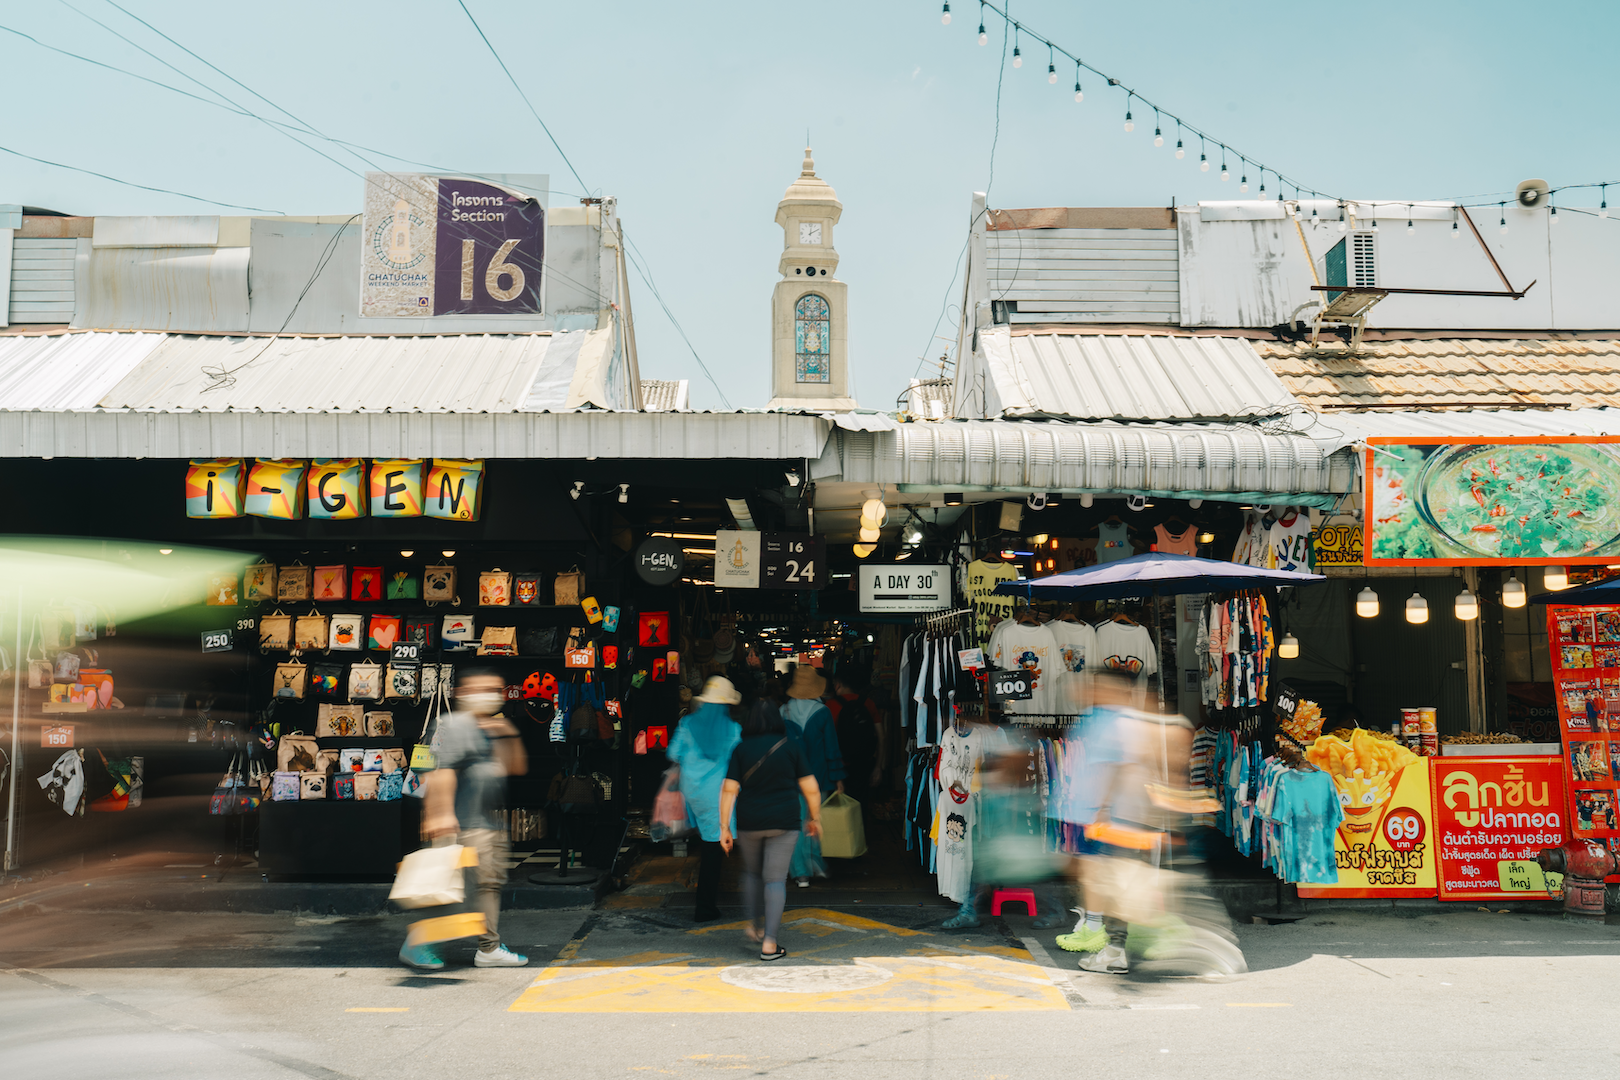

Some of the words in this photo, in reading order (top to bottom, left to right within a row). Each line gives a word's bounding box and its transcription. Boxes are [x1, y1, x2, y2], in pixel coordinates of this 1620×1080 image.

[451, 191, 503, 206] โครงการ
[451, 210, 505, 222] Section
[460, 238, 526, 302] 16
[368, 273, 428, 281] CHATUCHAK
[788, 542, 804, 553] 16
[785, 559, 815, 583] 24
[873, 575, 882, 589] A
[888, 575, 911, 589] DAY
[237, 619, 254, 630] 390
[206, 634, 228, 648] 250
[394, 645, 418, 658] 290
[571, 654, 588, 665] 150
[995, 679, 1026, 694] 100
[1277, 695, 1296, 714] 100
[58, 727, 72, 736] SALE
[48, 733, 67, 745] 150
[1442, 764, 1550, 828] ลูกชิ้น
[1480, 807, 1560, 829] ปลาทอด
[1387, 816, 1420, 841] 69
[1443, 830, 1562, 846] ต้นตำรับความอร่อย
[1396, 841, 1411, 850] บาท
[1508, 862, 1525, 874] เล็ก
[1366, 868, 1416, 885] ราดชีส
[1445, 879, 1500, 891] สูตรมะนาวสด
[1509, 877, 1531, 890] ใหญ่
